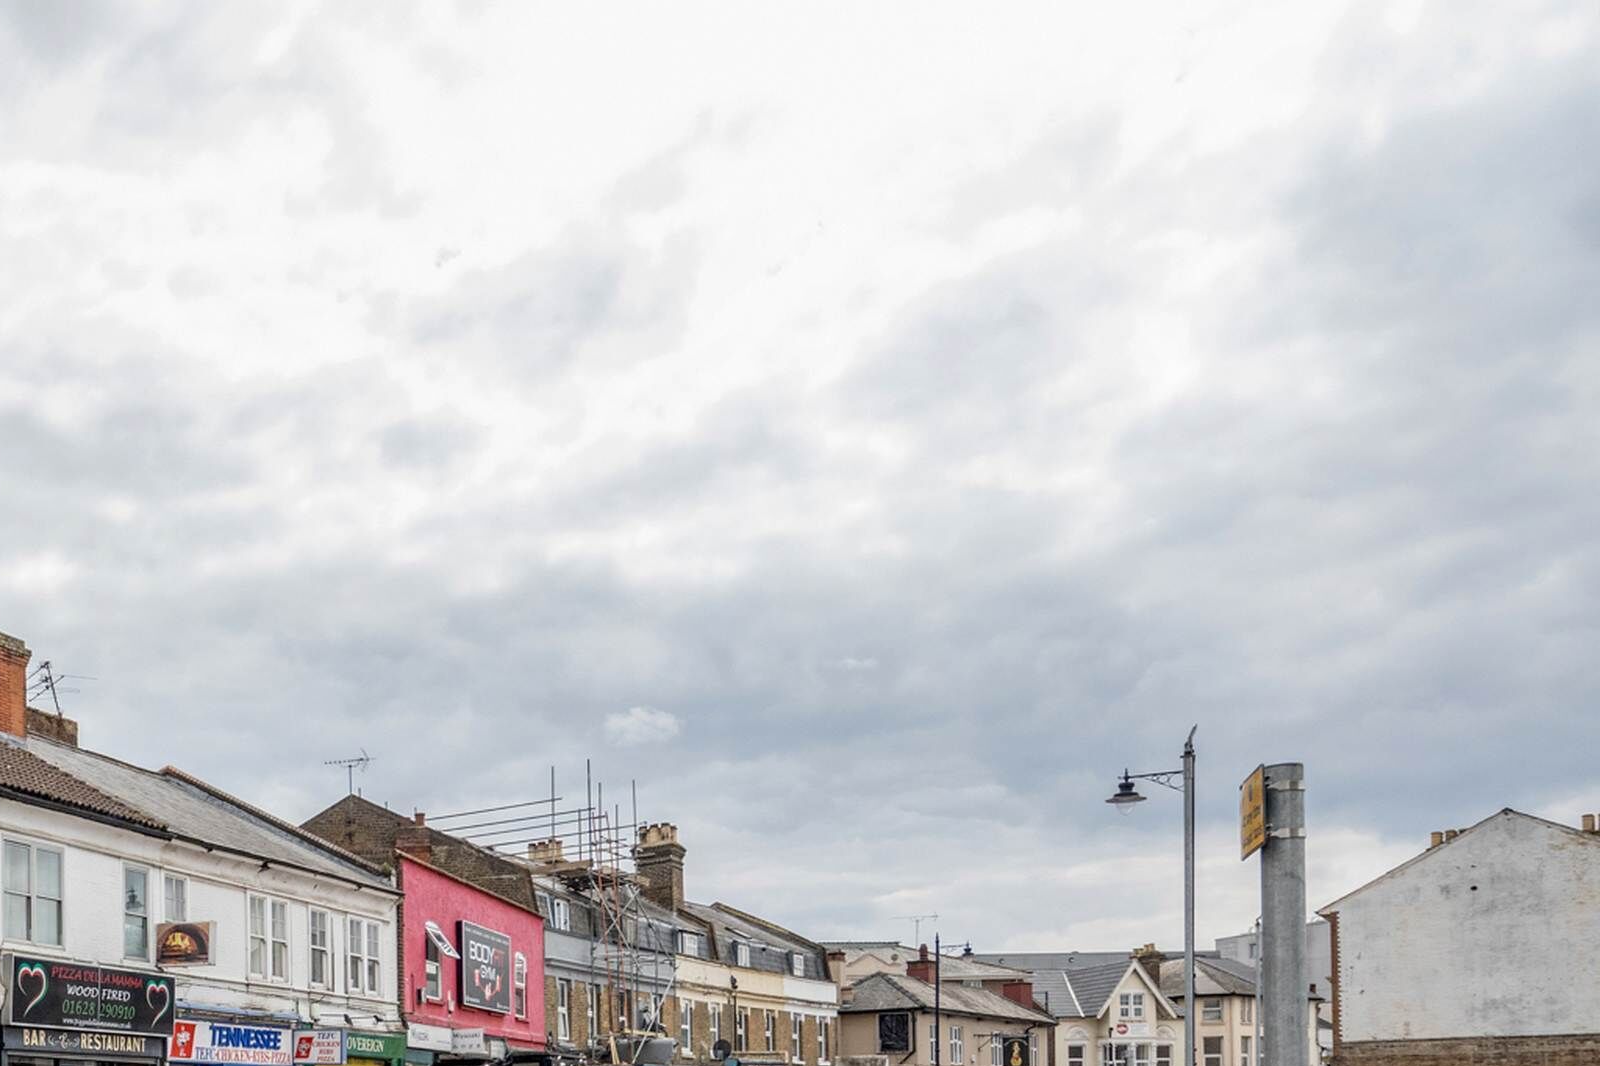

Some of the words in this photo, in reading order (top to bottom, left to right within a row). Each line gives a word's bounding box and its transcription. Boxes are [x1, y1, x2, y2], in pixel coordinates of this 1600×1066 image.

[51, 965, 82, 981] PIZZA
[66, 984, 98, 998] WOOD
[101, 988, 131, 1002] FIRED
[62, 999, 95, 1017] 01628
[99, 1002, 136, 1020] 290910
[23, 1029, 47, 1047] BAR
[80, 1032, 147, 1053] RESTAURANT
[208, 1024, 282, 1050] TENNESSEE
[346, 1036, 385, 1053] OVEREIGN
